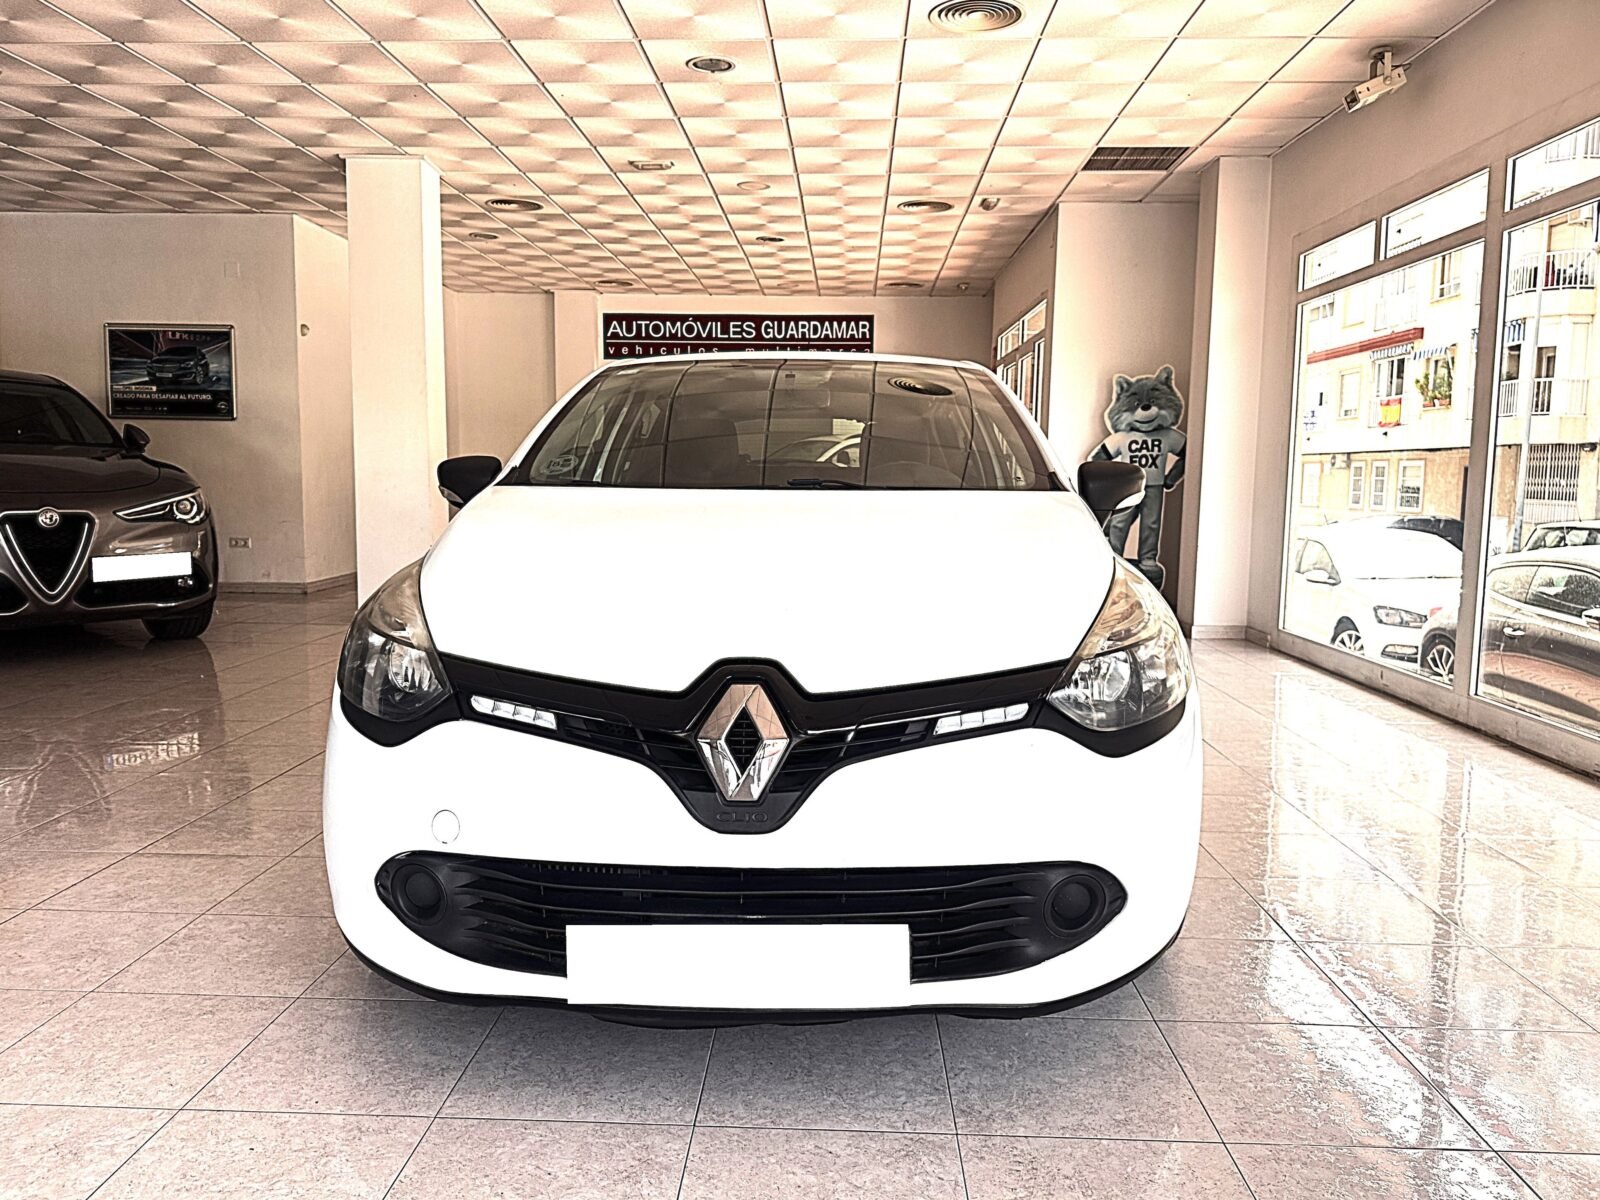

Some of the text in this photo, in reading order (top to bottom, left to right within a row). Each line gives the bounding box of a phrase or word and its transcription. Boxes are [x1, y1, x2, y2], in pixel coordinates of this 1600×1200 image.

[607, 317, 870, 339] AUTOMÓVILES GUARDAMAR
[1128, 439, 1162, 453] CAR
[1129, 453, 1159, 469] FOX
[716, 812, 769, 823] CLIO
